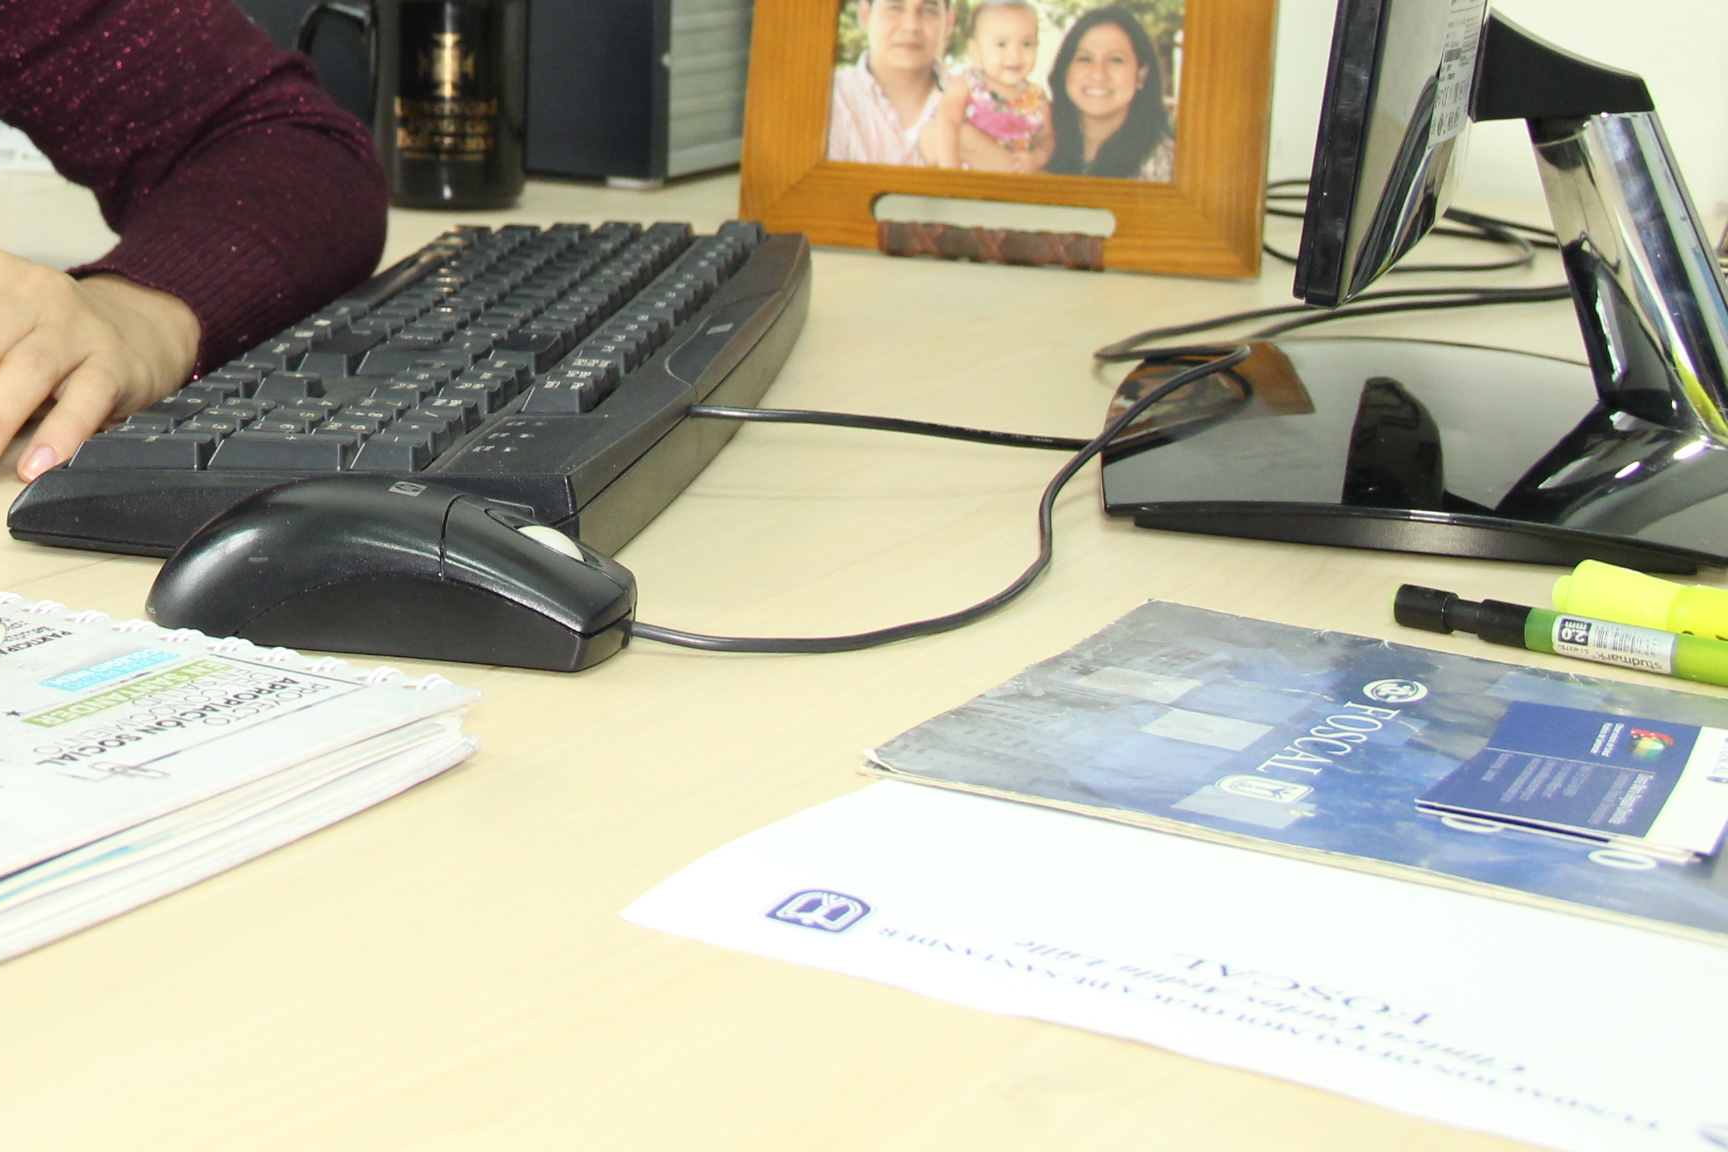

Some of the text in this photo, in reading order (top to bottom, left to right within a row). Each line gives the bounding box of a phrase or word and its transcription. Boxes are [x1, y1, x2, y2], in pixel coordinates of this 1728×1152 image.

[1560, 627, 1589, 644] 2.0
[1564, 620, 1591, 630] mm
[84, 648, 163, 671] COLEGIO
[1598, 651, 1663, 672] studmark
[26, 661, 225, 724] EN SANTANDER
[122, 666, 255, 708] EN SALUD
[193, 681, 334, 727] PROYECTO
[22, 671, 280, 756] DEL CONOCIMIENTO
[32, 677, 315, 768] APROPIACIÓN SOCIAL
[1256, 701, 1401, 775] FOSCAL
[877, 925, 1068, 981] SANTANDER
[1117, 965, 1220, 994] Ardila
[1174, 953, 1432, 1026] FOSCAL
[1244, 993, 1366, 1030] Carlos
